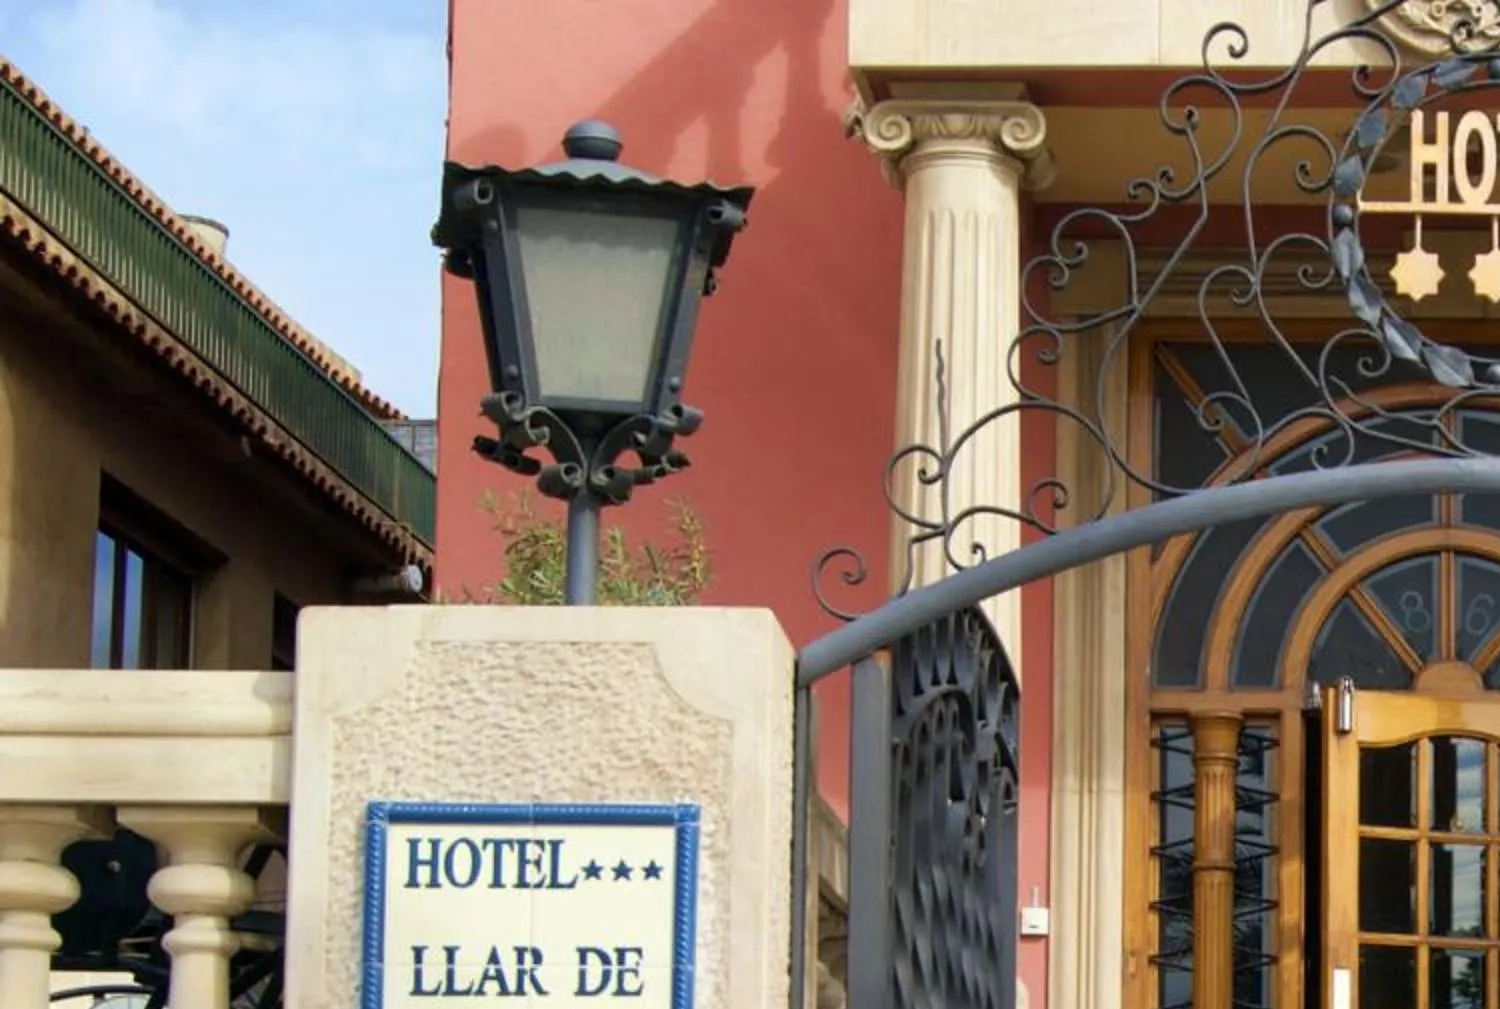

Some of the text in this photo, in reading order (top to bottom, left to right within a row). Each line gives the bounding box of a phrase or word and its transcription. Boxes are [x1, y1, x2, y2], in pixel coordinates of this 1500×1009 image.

[403, 837, 579, 889] HOTEL
[409, 945, 645, 997] LLAR DE
